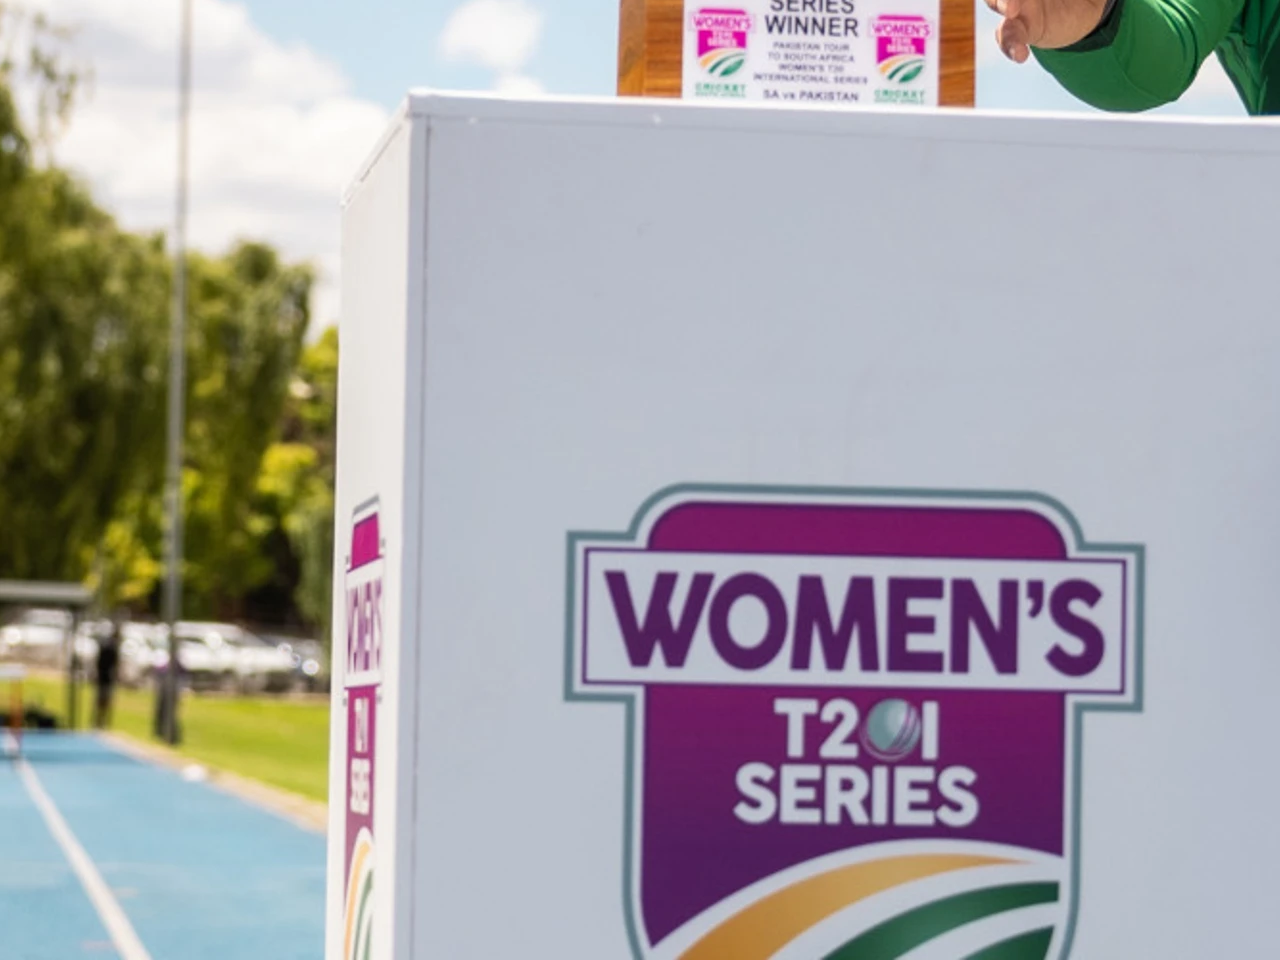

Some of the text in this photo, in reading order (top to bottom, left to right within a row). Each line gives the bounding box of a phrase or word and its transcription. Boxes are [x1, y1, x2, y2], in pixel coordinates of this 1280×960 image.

[693, 16, 752, 29] WOMEN'S
[764, 14, 859, 37] WINNER
[872, 23, 930, 36] WOMEN'S
[773, 41, 850, 52] PAKISTAN TOUR
[768, 51, 855, 63] TO SOUTH AFRICA
[779, 63, 824, 72] WOMEN'S
[753, 72, 868, 85] INTERNATIONAL SERIES
[763, 89, 779, 99] SA
[799, 90, 859, 101] PAKISTAN
[733, 761, 980, 827] SERIES
